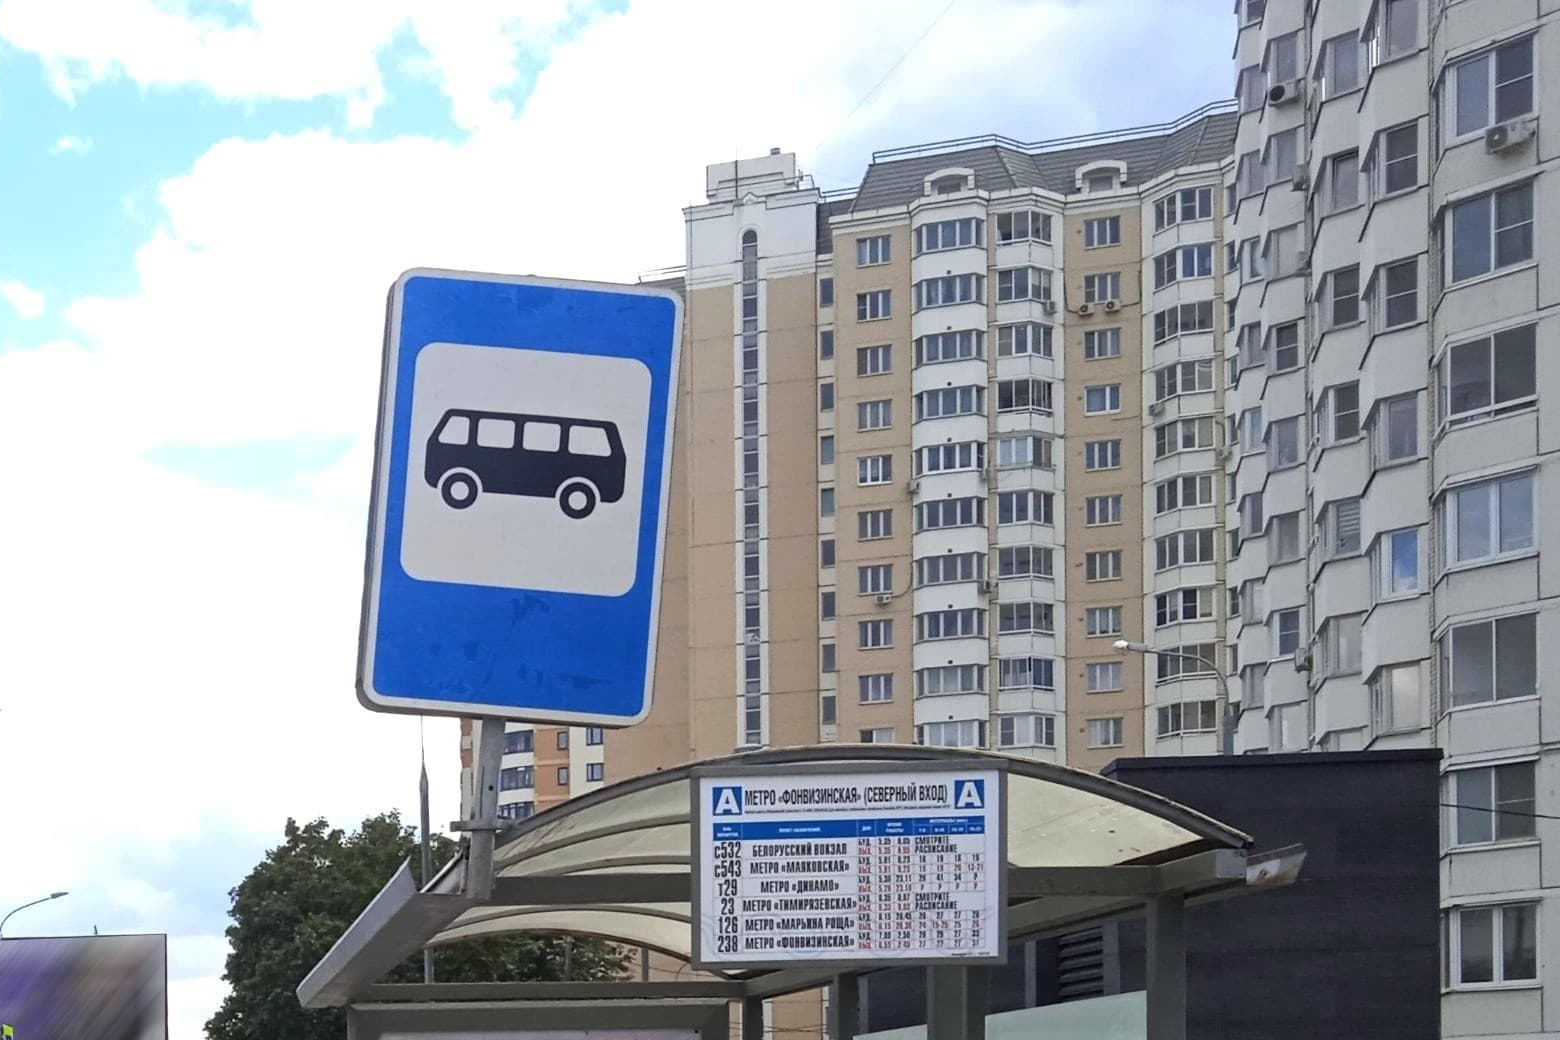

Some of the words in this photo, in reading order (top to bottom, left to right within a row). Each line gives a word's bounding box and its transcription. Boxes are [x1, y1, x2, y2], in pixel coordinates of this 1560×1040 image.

[714, 788, 740, 814] А
[744, 789, 776, 806] МЕТРО
[778, 787, 861, 805] «ФОНВИЗИНСКАЯ»
[863, 782, 917, 805] (СЕВЕРНЫЙ
[919, 784, 948, 804] ВХОД)
[956, 781, 983, 807] А
[714, 842, 741, 859] с532
[752, 842, 812, 857] БЕЛОРУССКИЙ
[814, 843, 847, 856] ВОКЗАЛ
[714, 860, 741, 878] с543
[750, 862, 779, 874] МЕТРО
[781, 860, 849, 873] «МАЯКОВСКАЯ»
[718, 879, 738, 896] т29
[760, 881, 789, 893] МЕТРО
[792, 879, 839, 894] «ДИНАМО»
[721, 898, 735, 915] 23
[743, 900, 772, 912] МЕТРО
[774, 898, 857, 911] «ТИМИРЯЗЕВСКАЯ»
[718, 916, 738, 934] 126
[745, 919, 774, 931] МЕТРО
[776, 918, 823, 930] «МАРЬИНА
[825, 917, 855, 930] РОЩА»
[717, 935, 738, 953] 238
[745, 937, 774, 950] МЕТРО
[776, 935, 855, 949] «ФОНВИЗИНСКАЯ»
